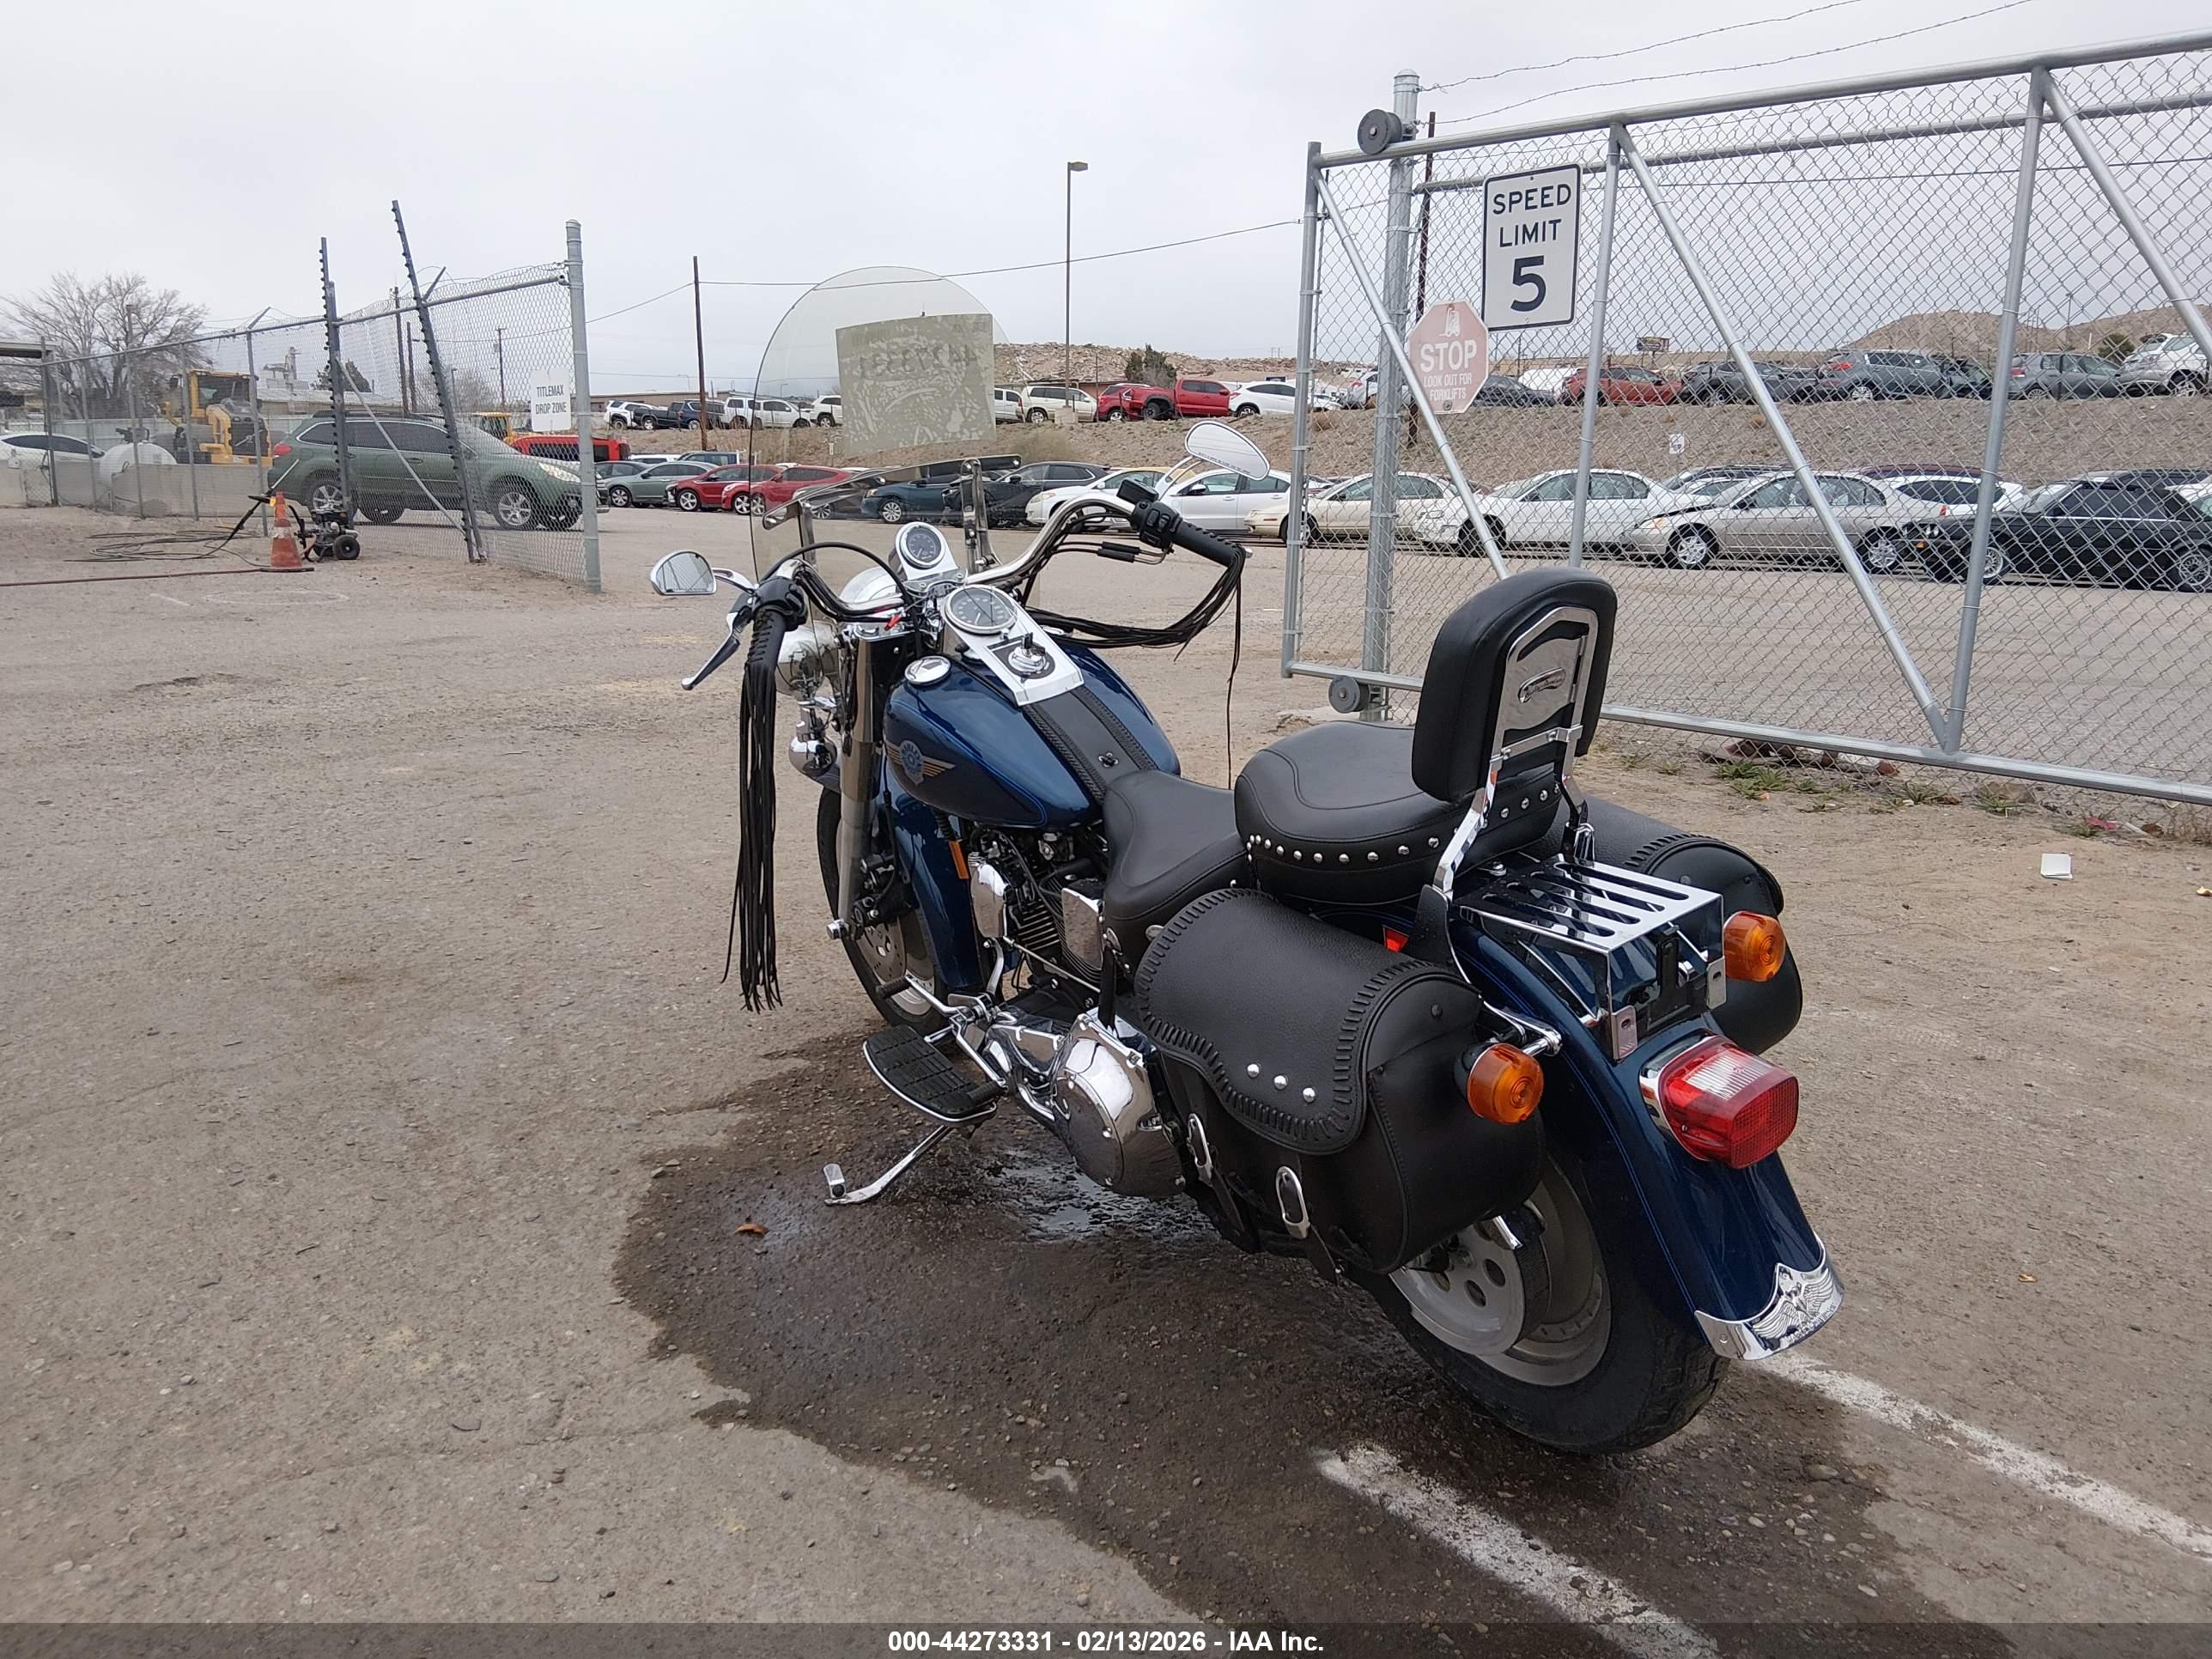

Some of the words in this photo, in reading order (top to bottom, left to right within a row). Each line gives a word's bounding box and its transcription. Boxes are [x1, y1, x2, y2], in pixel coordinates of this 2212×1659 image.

[1492, 184, 1571, 215] SPEED
[1499, 219, 1562, 248] LIMIT
[1510, 255, 1547, 312] 5
[1420, 339, 1477, 373] STOP
[1423, 374, 1443, 387] LOOK
[1444, 374, 1458, 386] OUT
[1459, 373, 1472, 385] FOR
[536, 384, 564, 398] TITLEMAX
[1430, 387, 1467, 401] FORKLIFTS
[535, 403, 550, 415] DROP
[551, 401, 567, 413] ZONE
